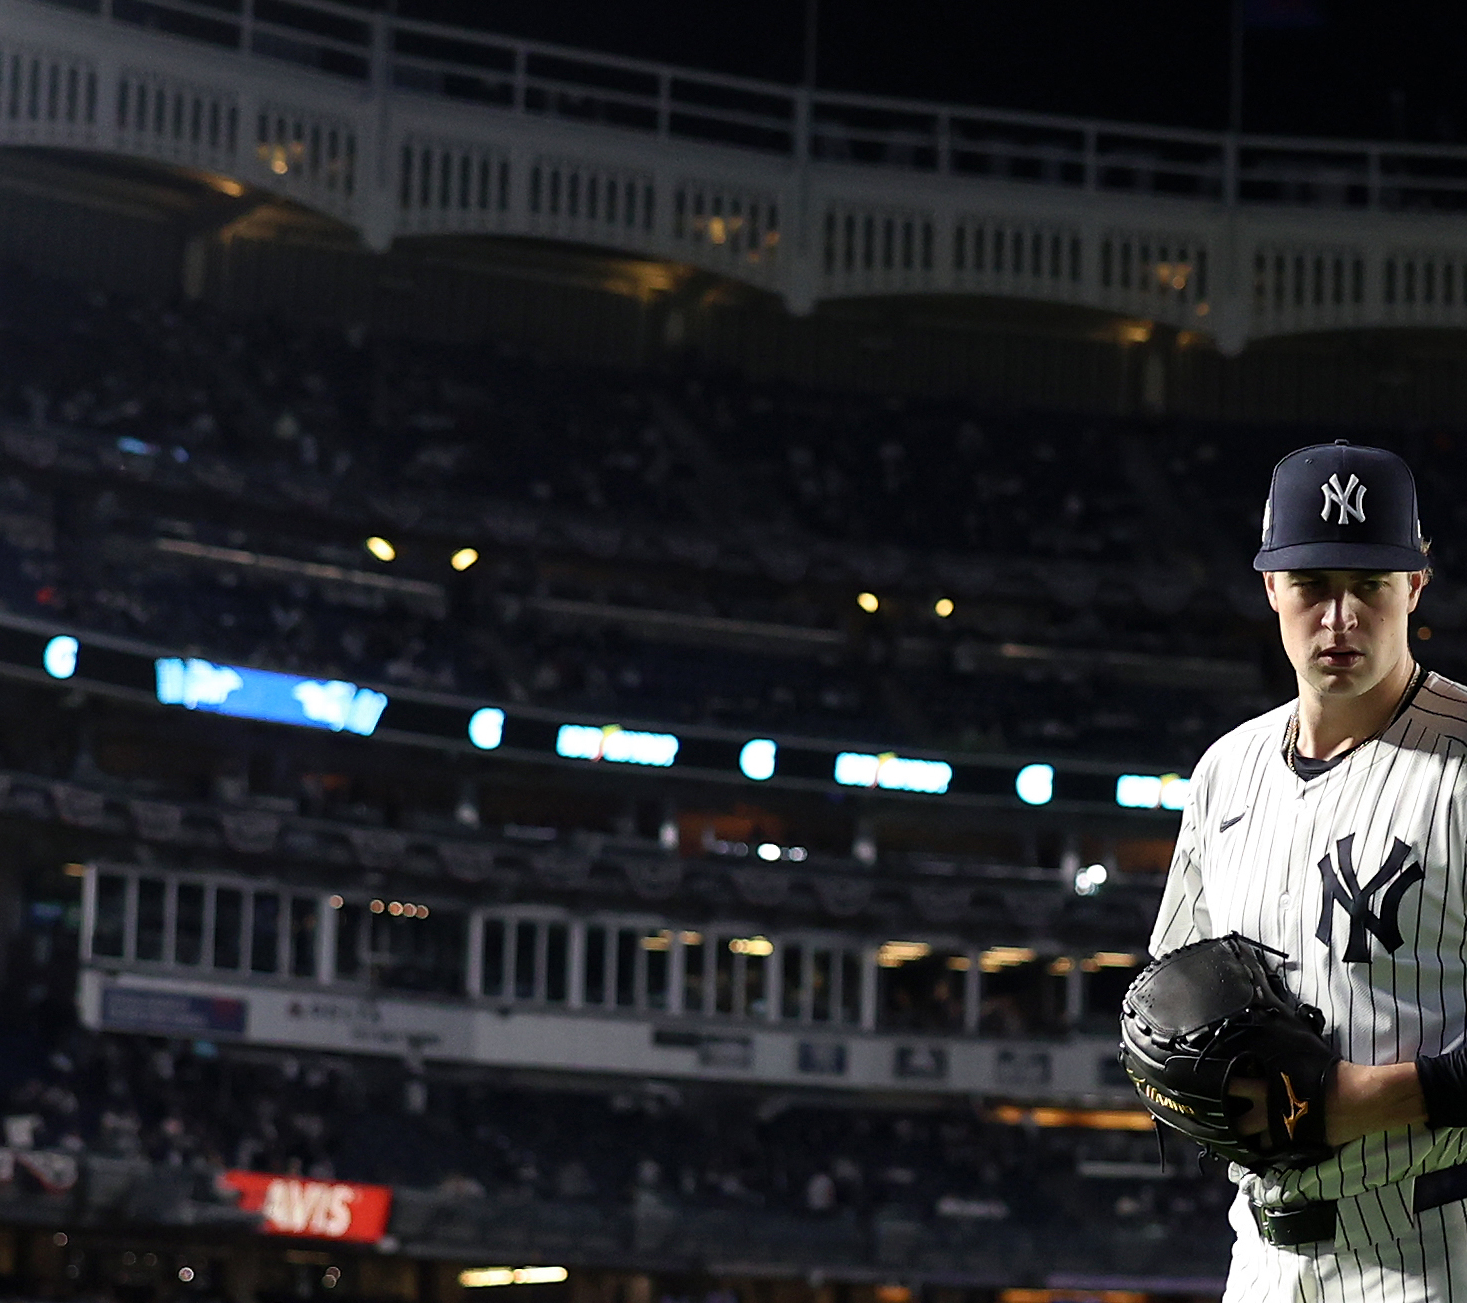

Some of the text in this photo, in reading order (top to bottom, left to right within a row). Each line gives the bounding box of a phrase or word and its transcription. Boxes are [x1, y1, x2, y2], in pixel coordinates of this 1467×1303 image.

[1320, 473, 1368, 525] NY
[1315, 832, 1425, 964] NY
[263, 1179, 356, 1237] AVIS
